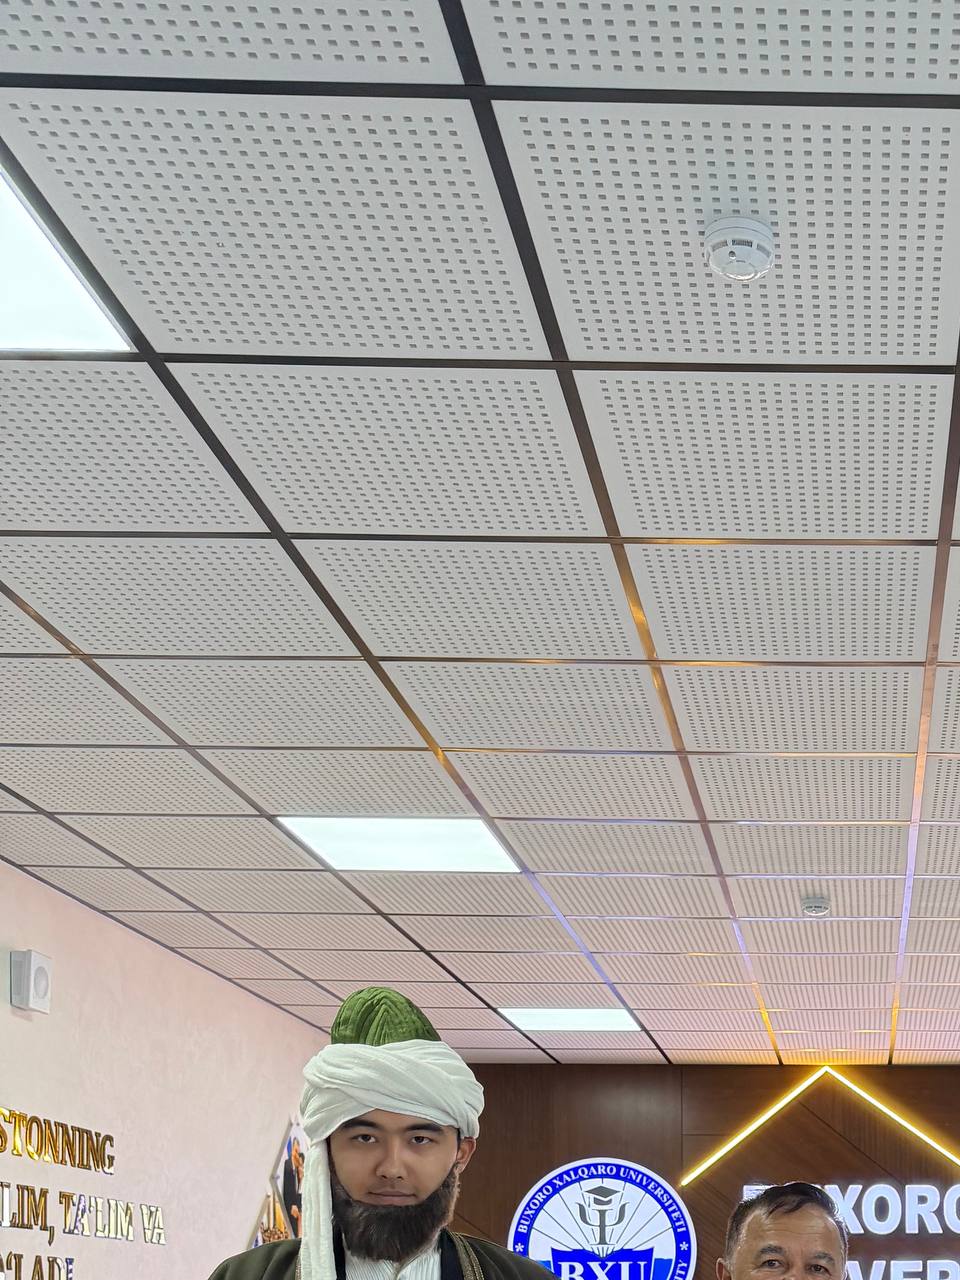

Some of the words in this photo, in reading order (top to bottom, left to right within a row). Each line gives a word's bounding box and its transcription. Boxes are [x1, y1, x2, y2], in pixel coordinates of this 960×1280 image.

[0, 1182, 54, 1246] LIM,
[59, 1191, 134, 1241] TA'LIM
[140, 1204, 167, 1245] VA
[517, 1185, 553, 1234] BUXORO
[554, 1165, 617, 1189] XALQARO
[620, 1167, 687, 1233] UNIVERSITETI
